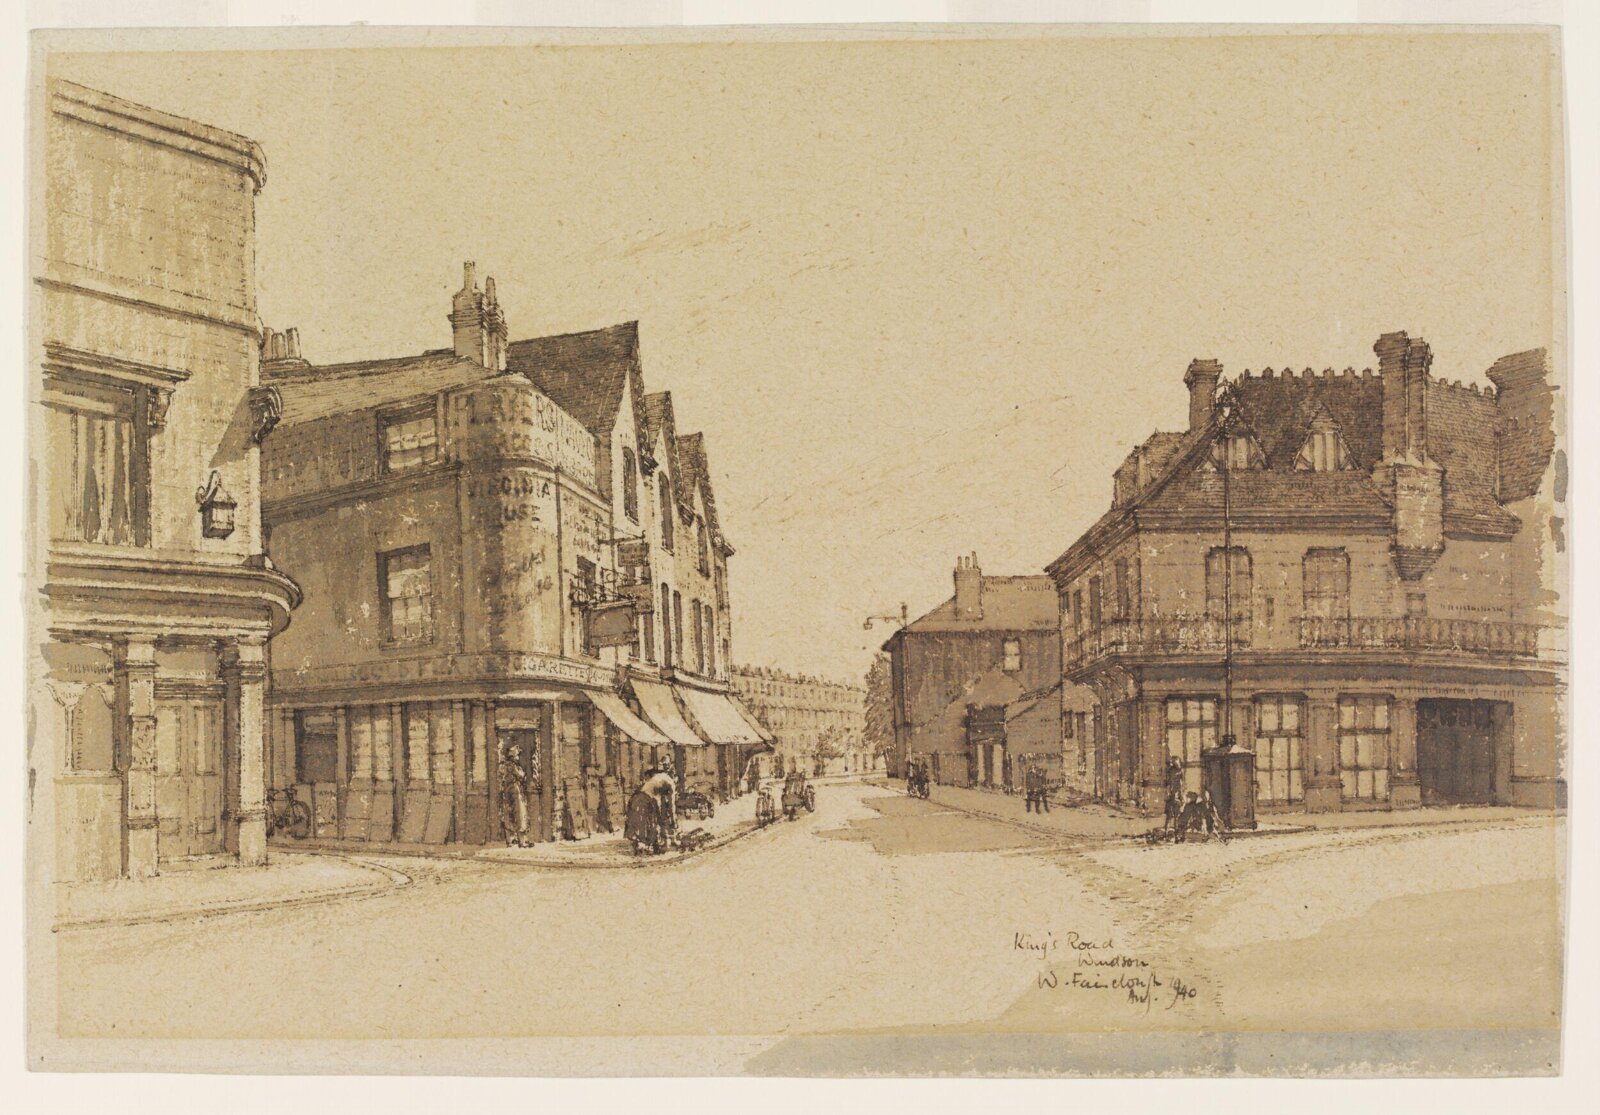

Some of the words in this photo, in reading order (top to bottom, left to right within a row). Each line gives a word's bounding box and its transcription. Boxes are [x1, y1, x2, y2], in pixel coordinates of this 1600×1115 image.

[1014, 932, 1057, 960] King's
[1067, 931, 1115, 950] Road
[1078, 953, 1149, 968] Windsor
